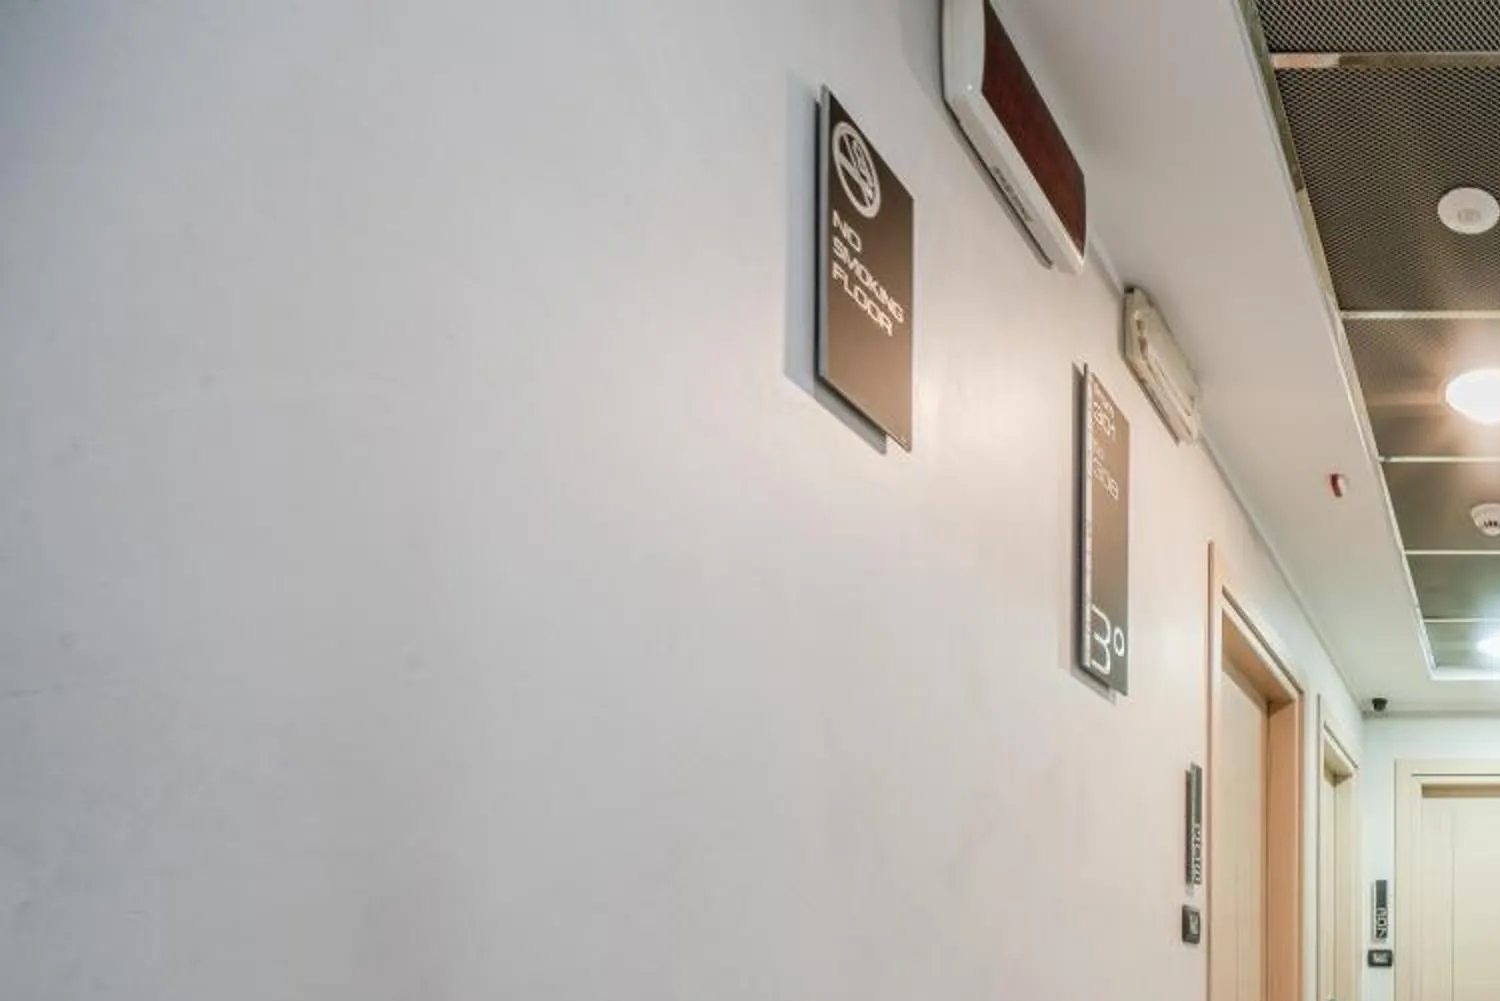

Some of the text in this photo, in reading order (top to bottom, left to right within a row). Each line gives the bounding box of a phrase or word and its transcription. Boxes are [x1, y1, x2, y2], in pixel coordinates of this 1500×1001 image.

[832, 209, 862, 253] NO
[832, 236, 904, 323] SMOKING
[832, 261, 893, 337] FLOOR
